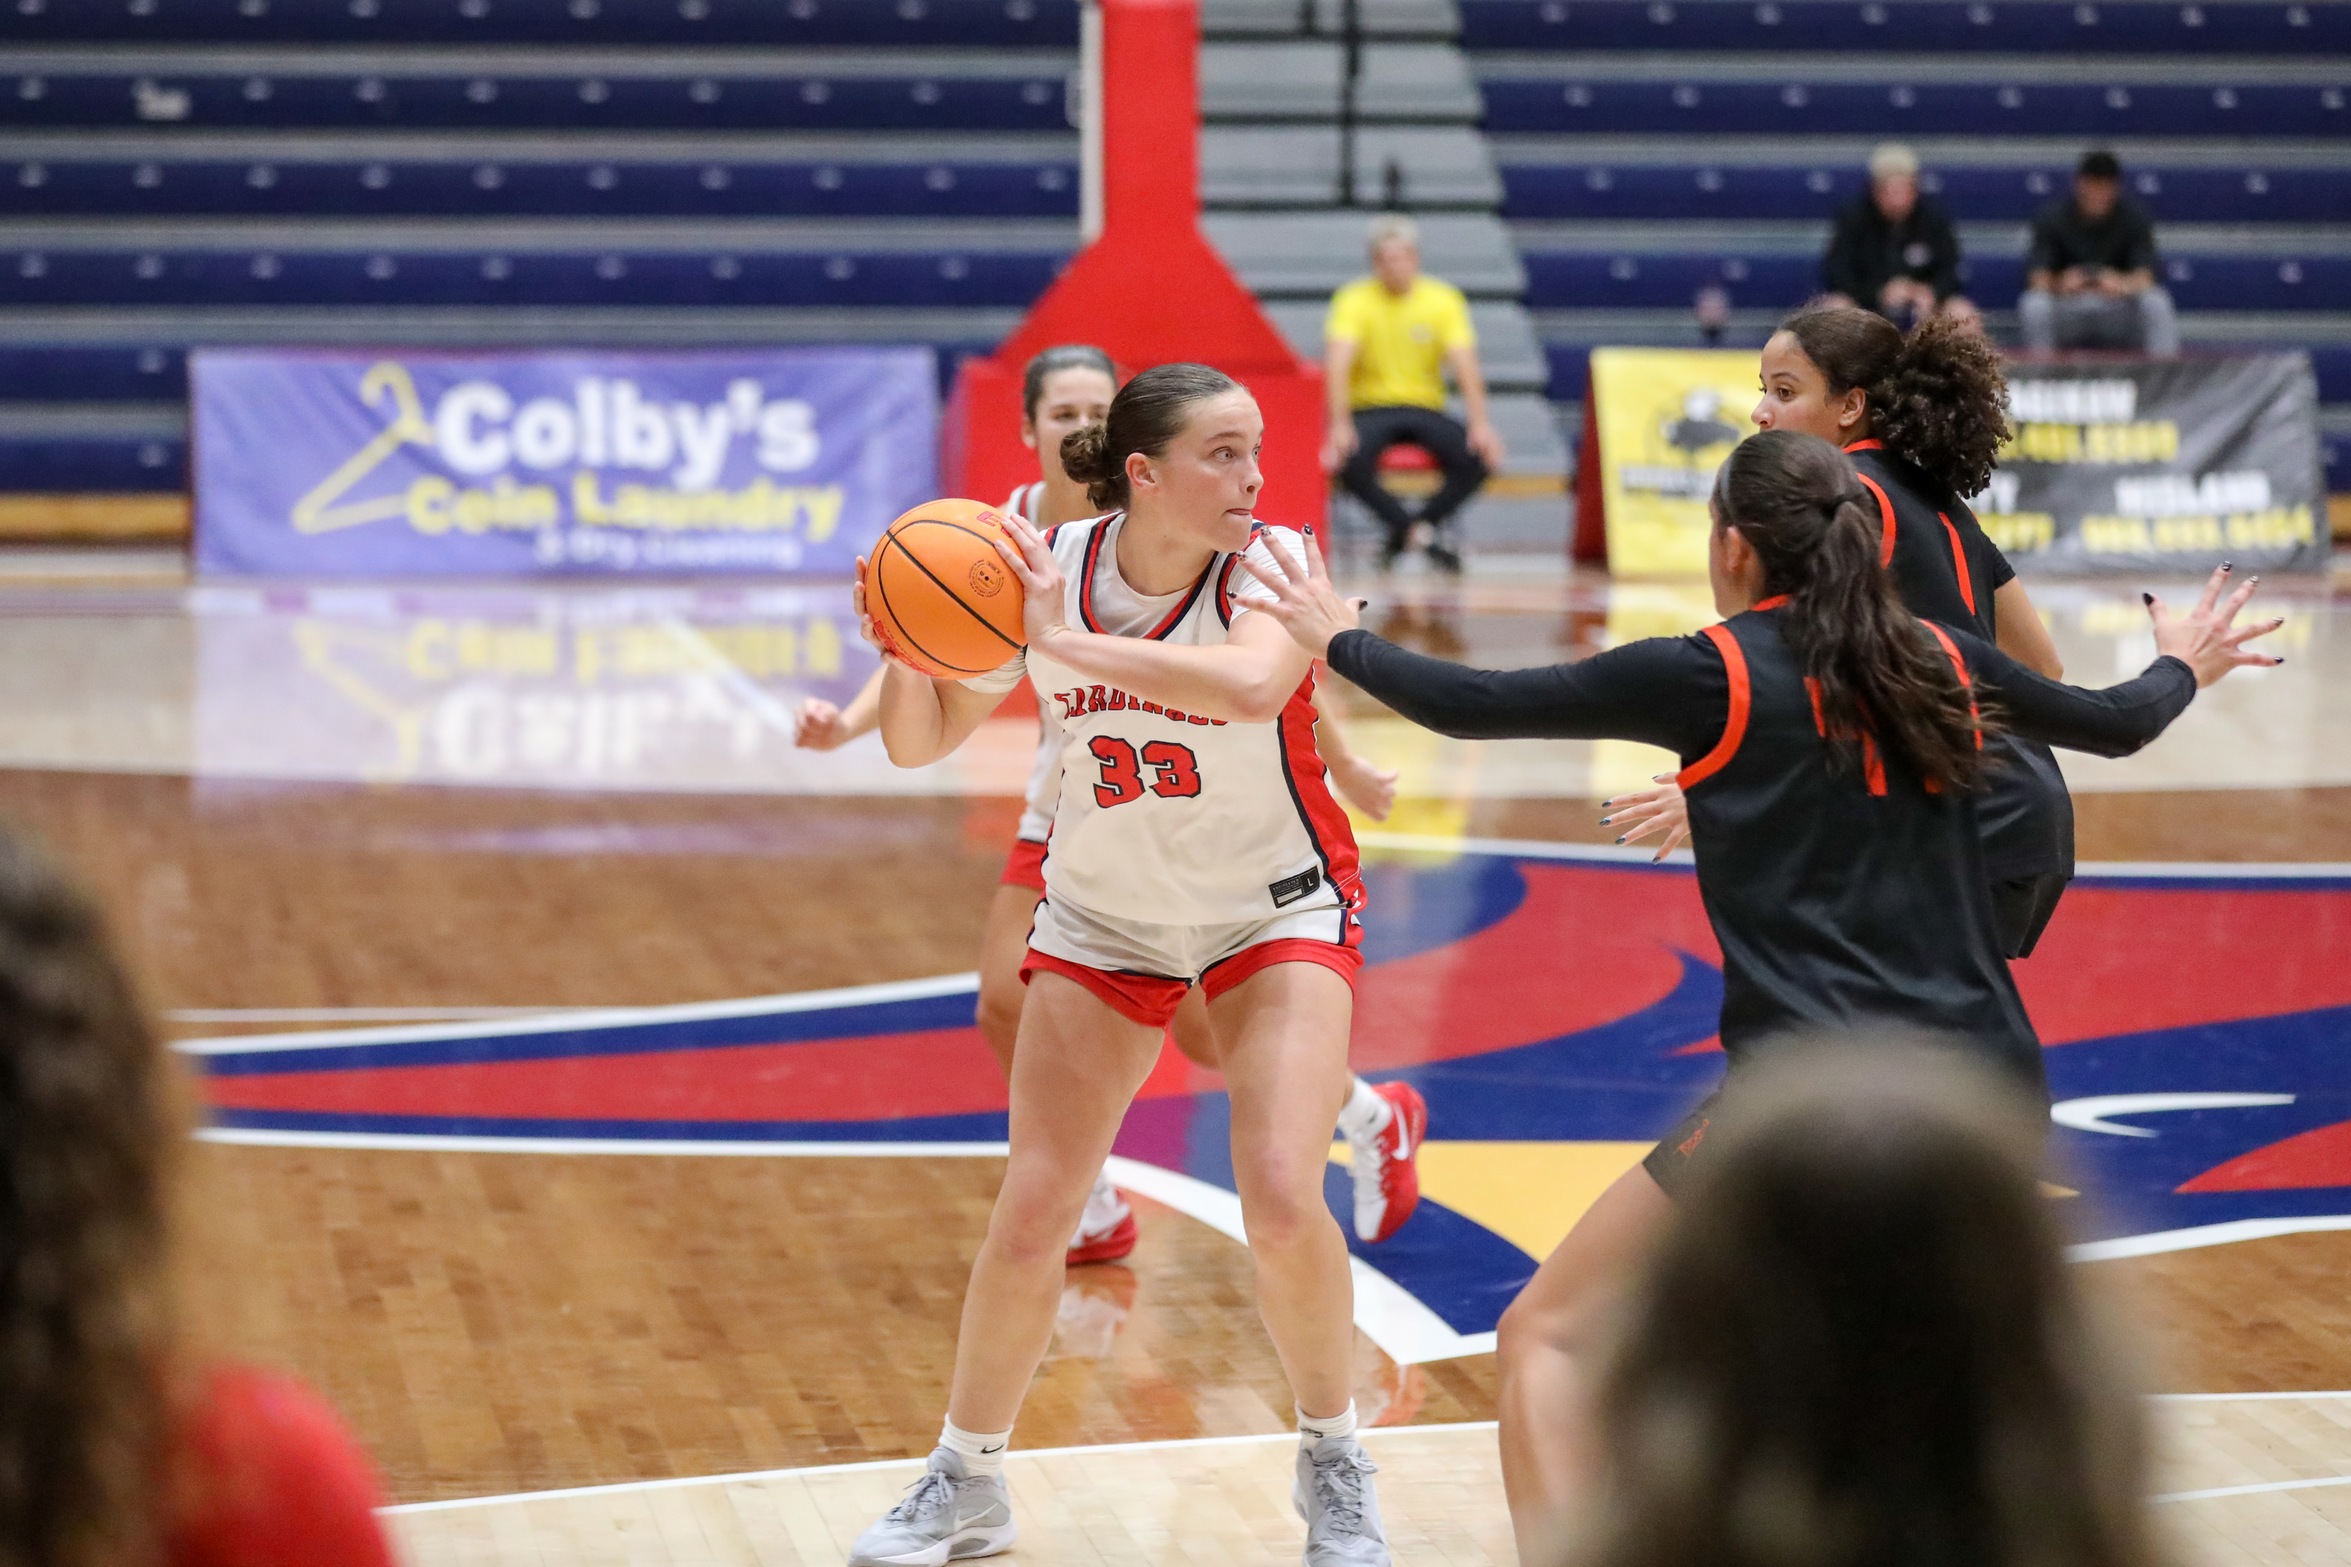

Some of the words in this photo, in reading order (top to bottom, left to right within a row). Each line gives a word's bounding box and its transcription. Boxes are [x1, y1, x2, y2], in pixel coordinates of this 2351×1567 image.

[436, 377, 820, 487] Colby's
[406, 474, 557, 533] Coin
[574, 470, 843, 542] Laundry
[1087, 735, 1202, 809] 33
[1306, 877, 1314, 887] L
